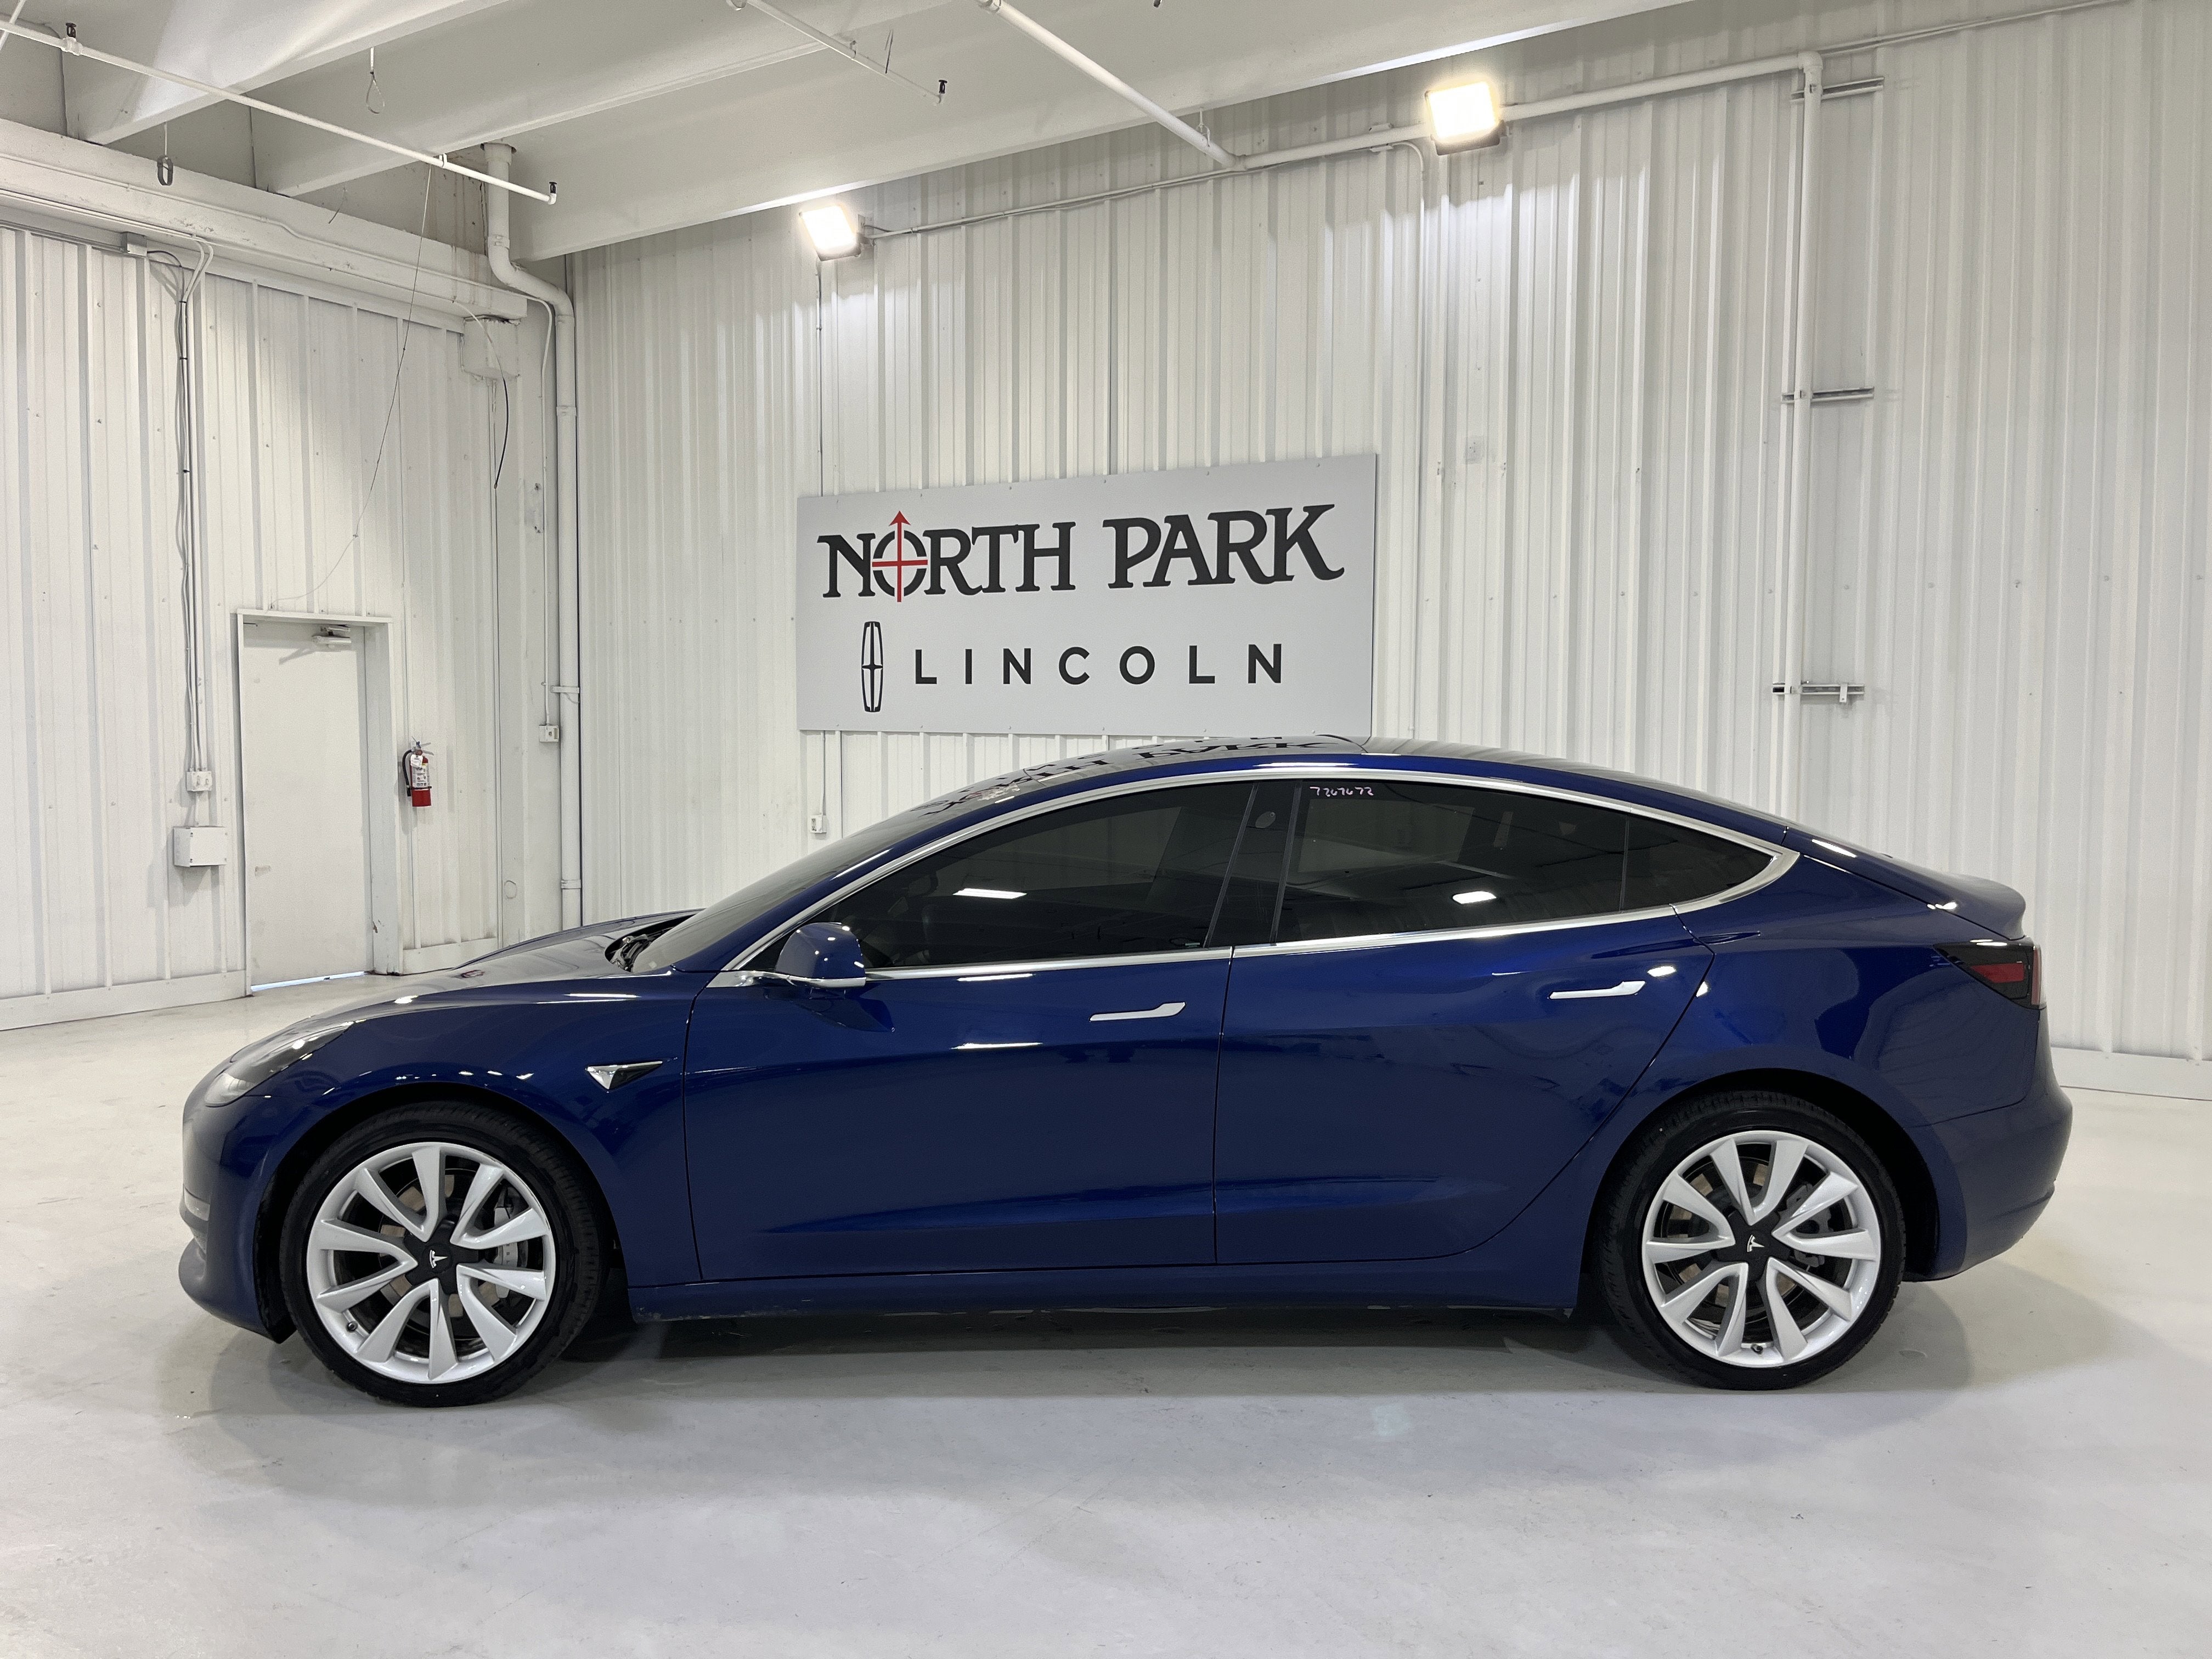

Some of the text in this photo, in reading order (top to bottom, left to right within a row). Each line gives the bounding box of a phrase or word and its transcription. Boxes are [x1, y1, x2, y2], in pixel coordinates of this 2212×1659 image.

[816, 504, 1345, 599] NORTH PARK
[915, 643, 1282, 685] LINCOLN
